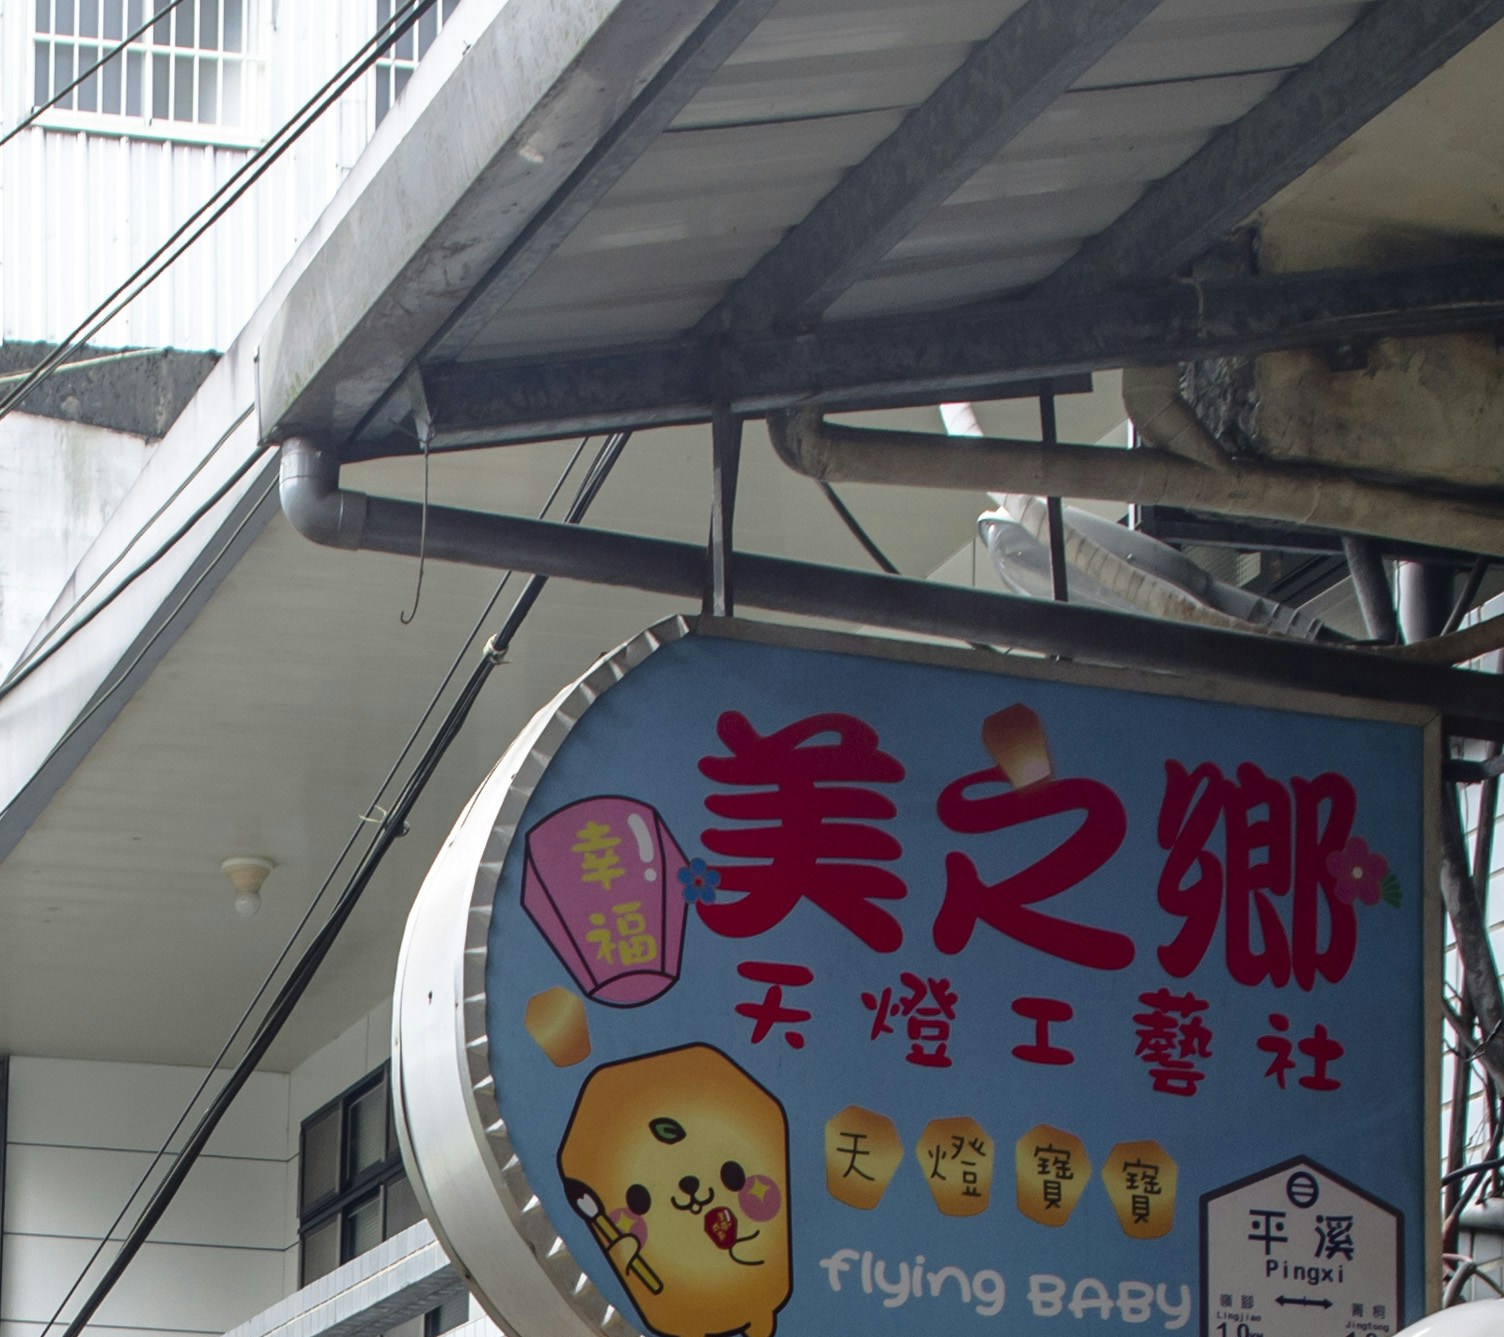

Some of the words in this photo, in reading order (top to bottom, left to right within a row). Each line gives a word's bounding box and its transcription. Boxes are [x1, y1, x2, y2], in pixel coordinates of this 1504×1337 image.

[571, 818, 659, 967] 幸福
[697, 708, 1360, 994] 美之鄉
[734, 960, 1344, 1098] 天燈工藝社
[834, 1130, 1166, 1230] 天燈寶寶
[1248, 1209, 1355, 1261] 平溪
[1264, 1259, 1345, 1286] Pingxi
